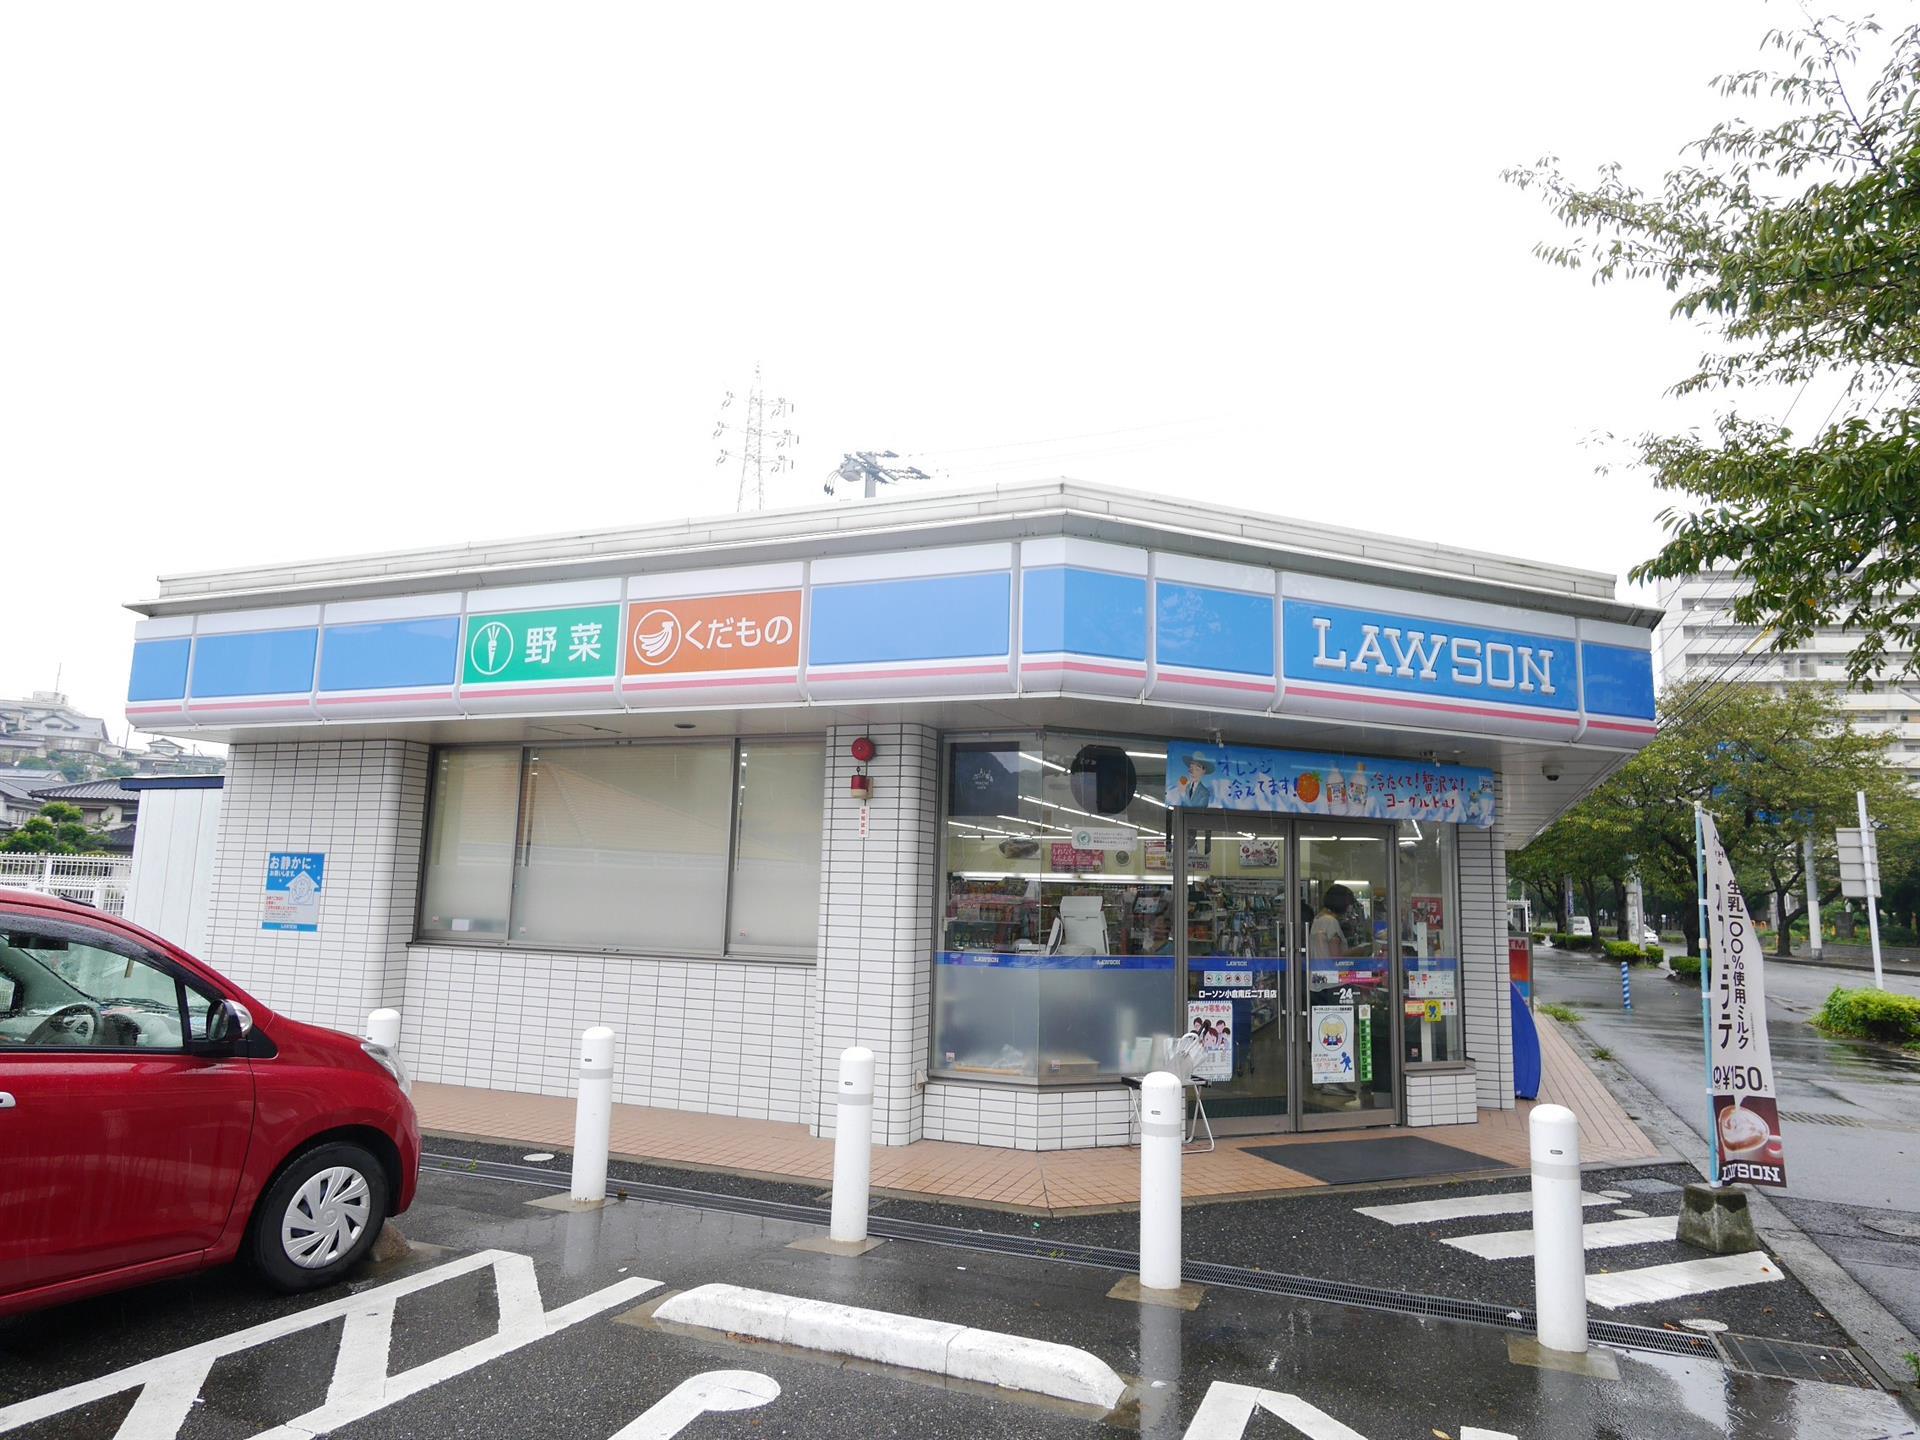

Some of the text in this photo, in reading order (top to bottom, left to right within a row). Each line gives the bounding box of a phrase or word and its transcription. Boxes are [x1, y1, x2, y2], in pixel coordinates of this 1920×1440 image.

[524, 622, 603, 664] 野菜
[685, 615, 793, 650] くだもの
[1311, 617, 1556, 695] LAWSON
[1217, 754, 1274, 777] オレンジ
[1228, 776, 1298, 800] 冷えてます!
[269, 856, 312, 870] お静かに
[1508, 939, 1526, 949] TM
[973, 955, 999, 963] LAWSON
[1339, 987, 1354, 1000] 24
[1722, 1065, 1763, 1091] ¥150
[1721, 1162, 1782, 1182] LWSON
